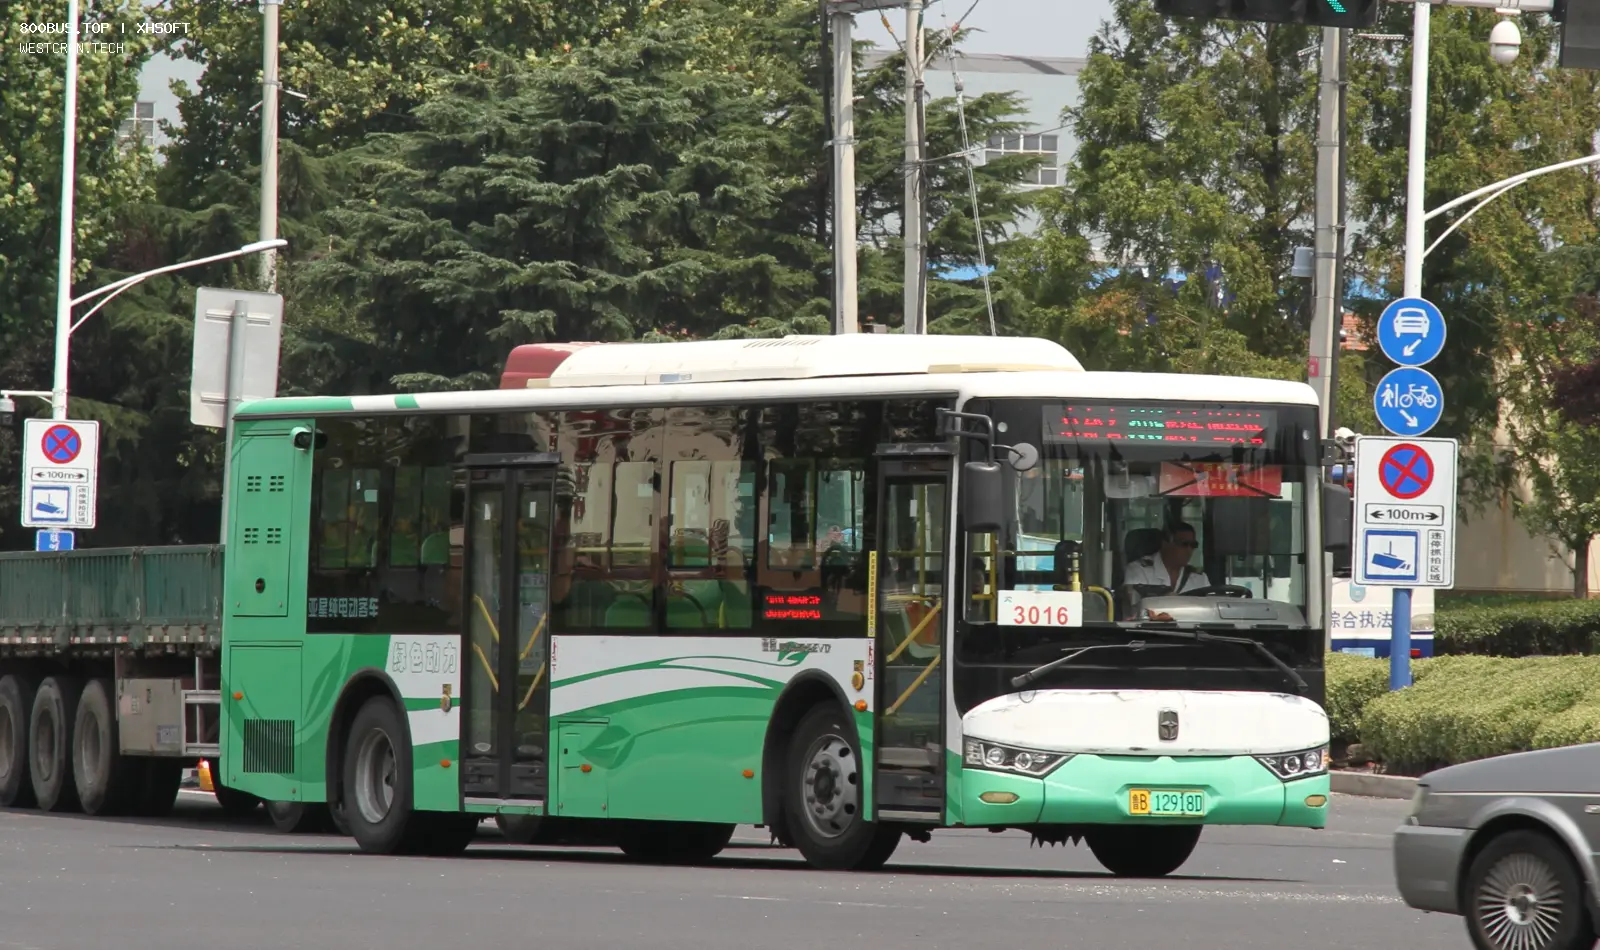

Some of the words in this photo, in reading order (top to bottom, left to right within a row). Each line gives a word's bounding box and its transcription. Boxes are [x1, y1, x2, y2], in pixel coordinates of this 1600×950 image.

[1386, 508, 1425, 520] 100m
[1013, 605, 1069, 626] 3016
[392, 641, 457, 674] 绿色动力
